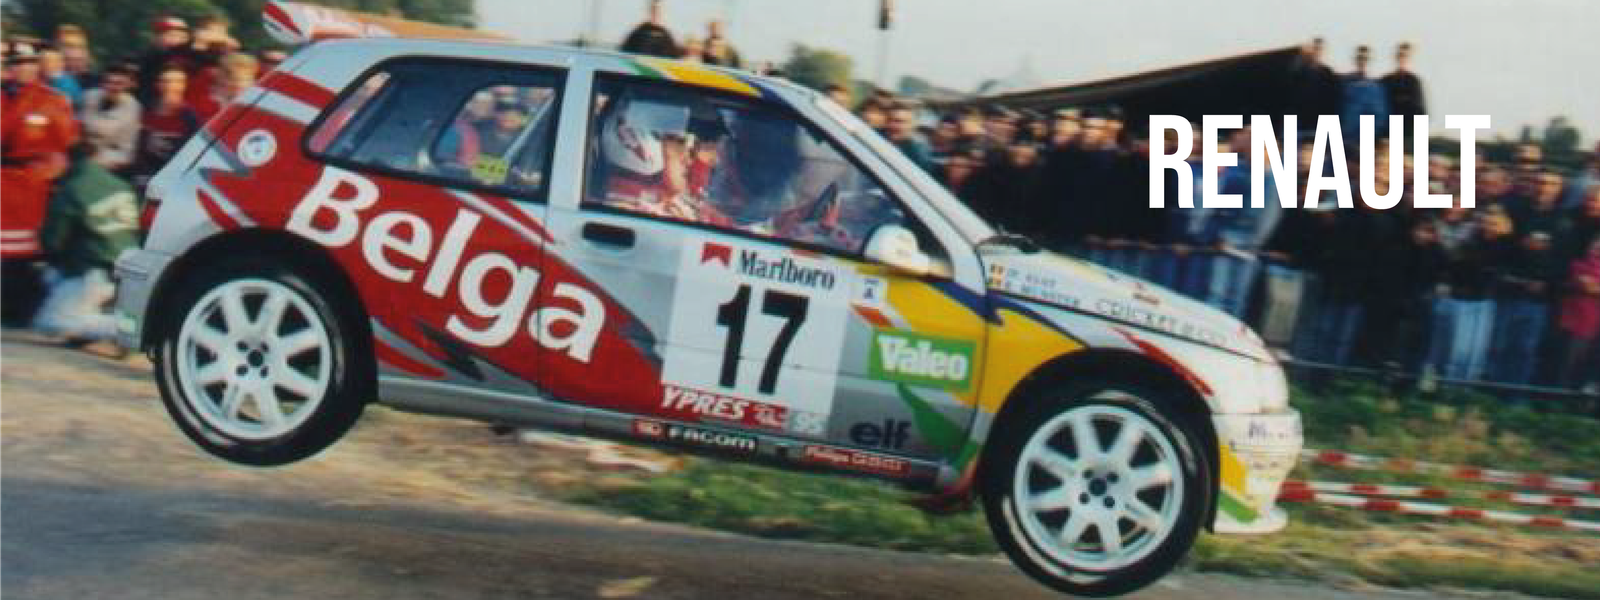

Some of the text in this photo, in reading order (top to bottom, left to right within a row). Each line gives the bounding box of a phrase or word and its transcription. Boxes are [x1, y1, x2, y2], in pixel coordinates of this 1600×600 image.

[286, 165, 605, 363] Belga
[739, 249, 835, 289] Marlboro
[717, 283, 810, 395] 17
[877, 334, 969, 381] Valeo
[660, 385, 749, 420] YPRES
[848, 420, 912, 450] elf
